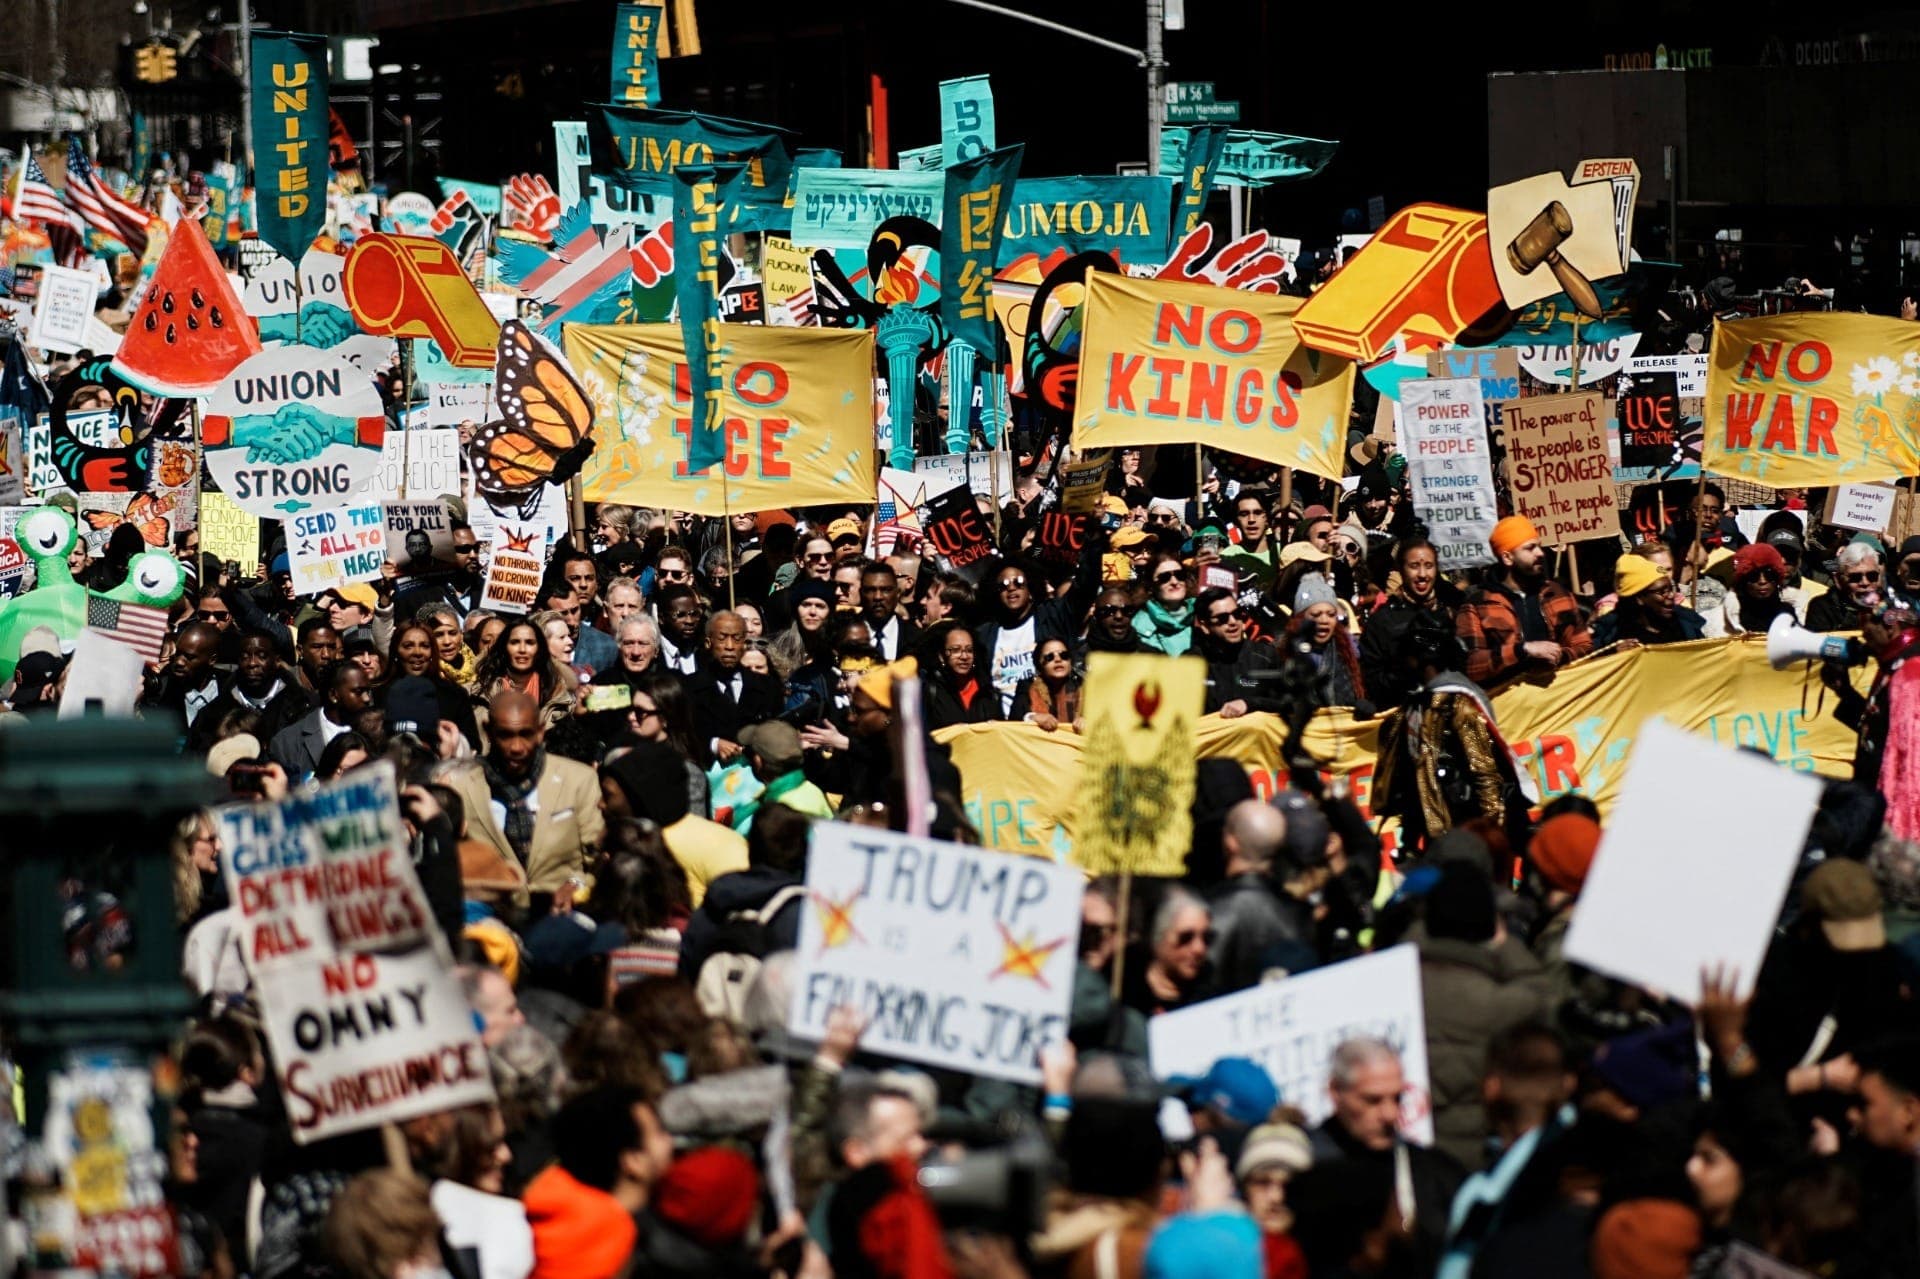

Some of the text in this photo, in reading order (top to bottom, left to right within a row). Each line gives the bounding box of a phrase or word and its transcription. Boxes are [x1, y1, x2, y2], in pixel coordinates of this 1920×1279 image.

[625, 15, 650, 108] UNITE
[1170, 105, 1194, 116] Wynn
[271, 62, 310, 218] UNITED
[1582, 160, 1633, 178] EPSTEIN
[1002, 201, 1150, 238] UMOJA
[771, 282, 797, 294] LAW
[1155, 302, 1263, 354] NO
[1447, 353, 1498, 377] WE
[1633, 358, 1678, 368] RELEASE
[1741, 340, 1832, 383] NO
[234, 368, 341, 404] UNION
[1106, 352, 1302, 429] KINGS
[1433, 390, 1451, 400] THE
[1418, 404, 1470, 420] POWER
[1505, 399, 1596, 437] The power of
[1625, 396, 1673, 430] WE
[1429, 424, 1462, 434] OF THE
[1726, 393, 1840, 456] WAR
[1419, 439, 1476, 454] PEOPLE
[1509, 430, 1600, 464] the people is
[1634, 430, 1675, 445] PEOPLE
[924, 458, 949, 470] ICE
[1443, 460, 1453, 470] IS
[1514, 454, 1611, 492] STRONGER
[32, 469, 58, 488] NO
[235, 463, 350, 499] STRONG
[1421, 475, 1479, 488] STRONGER
[1427, 492, 1475, 503] THAN THE
[1518, 485, 1613, 520] than the people
[1849, 488, 1885, 503] Empathy
[1856, 502, 1873, 510] over
[387, 505, 442, 516] NEW YORK
[1426, 507, 1482, 523] PEOPLE
[1847, 511, 1877, 523] Empire
[295, 512, 336, 537] SEND
[388, 515, 445, 531] FOR ALL
[928, 508, 982, 555] WE
[1042, 512, 1087, 550] WE
[1451, 527, 1461, 536] IN
[205, 525, 256, 543] REMOVE
[320, 529, 381, 556] ALL TO
[949, 540, 991, 568] PEOPLE
[1436, 544, 1484, 559] POWER
[344, 549, 388, 576] HAGU
[495, 556, 540, 571] NO THRONES
[491, 570, 539, 587] NO CROWNS
[488, 585, 504, 601] NO
[321, 813, 391, 850] WILL
[850, 840, 1049, 926] TRUMP
[253, 919, 311, 962] ALL
[321, 951, 378, 995] NO
[293, 983, 427, 1052] OMNY
